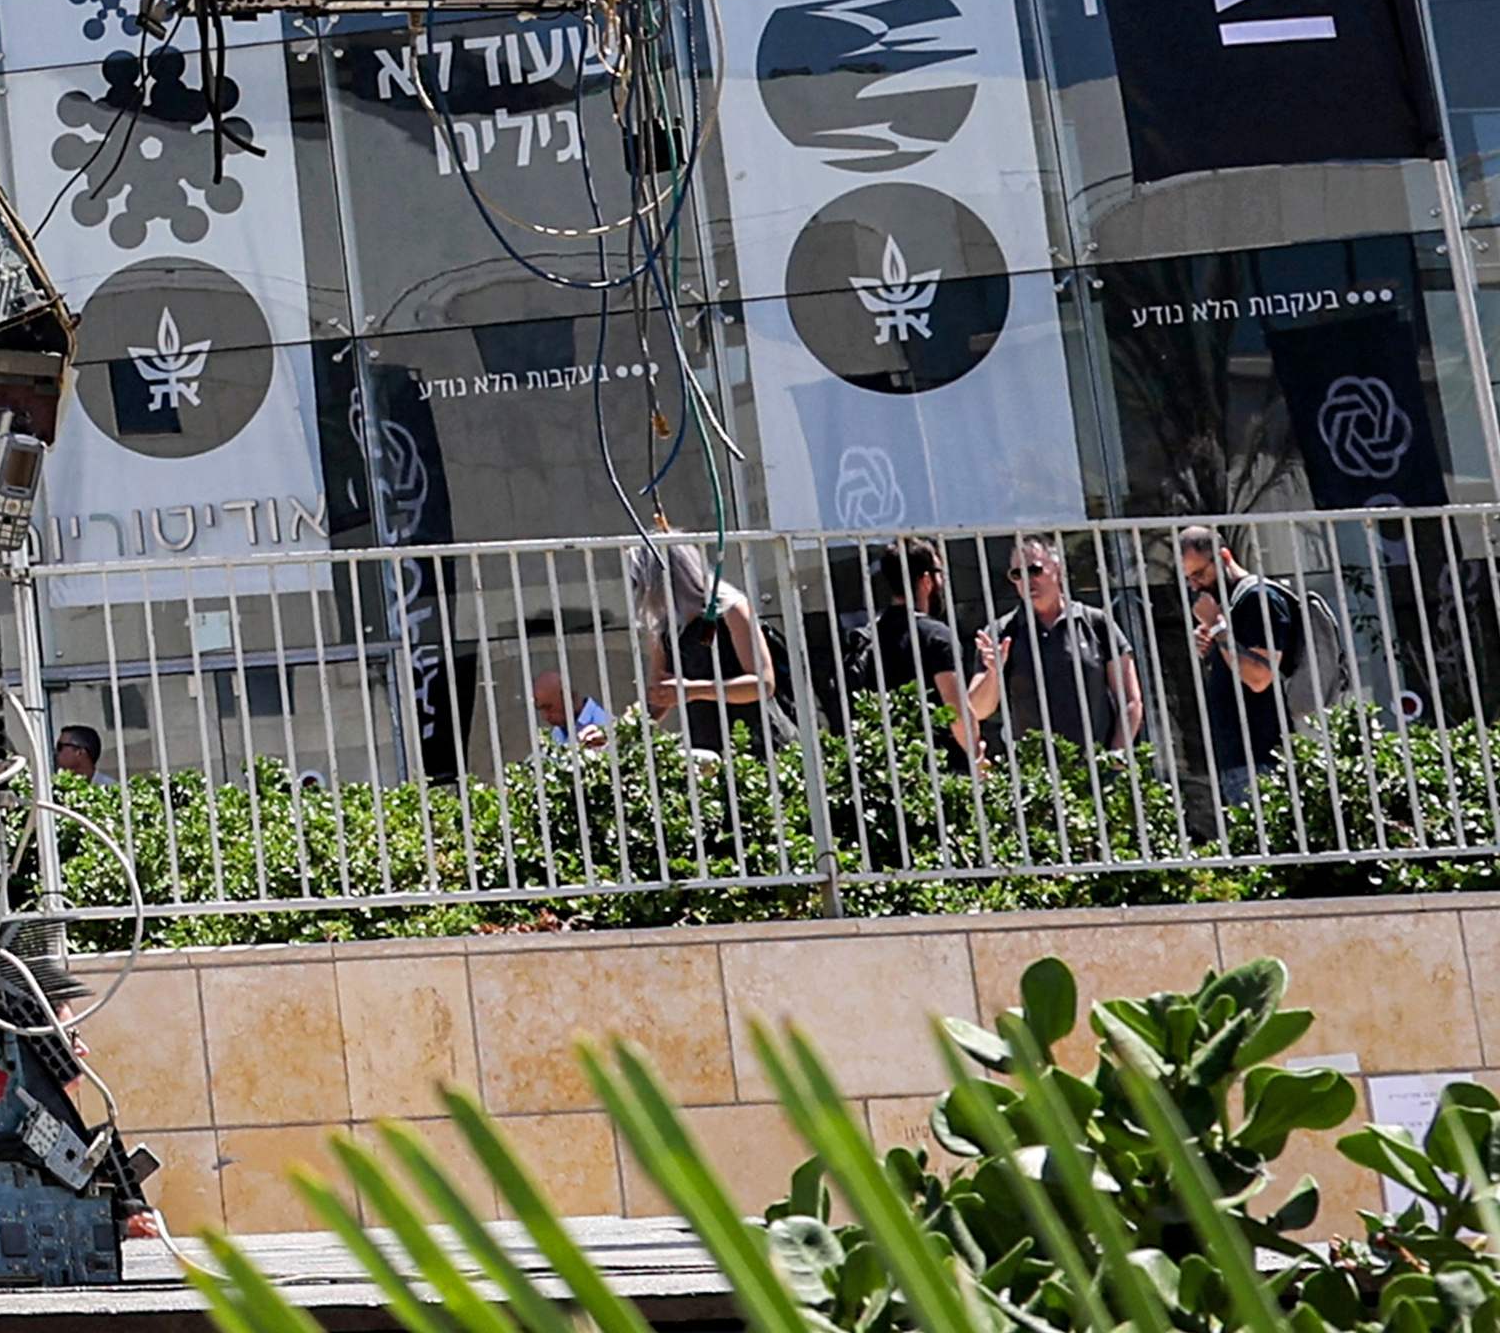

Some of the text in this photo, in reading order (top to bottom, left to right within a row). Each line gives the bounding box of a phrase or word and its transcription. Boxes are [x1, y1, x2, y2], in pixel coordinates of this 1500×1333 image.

[464, 25, 619, 88] שעוד
[1131, 289, 1340, 328] בעקבות הלא נודע
